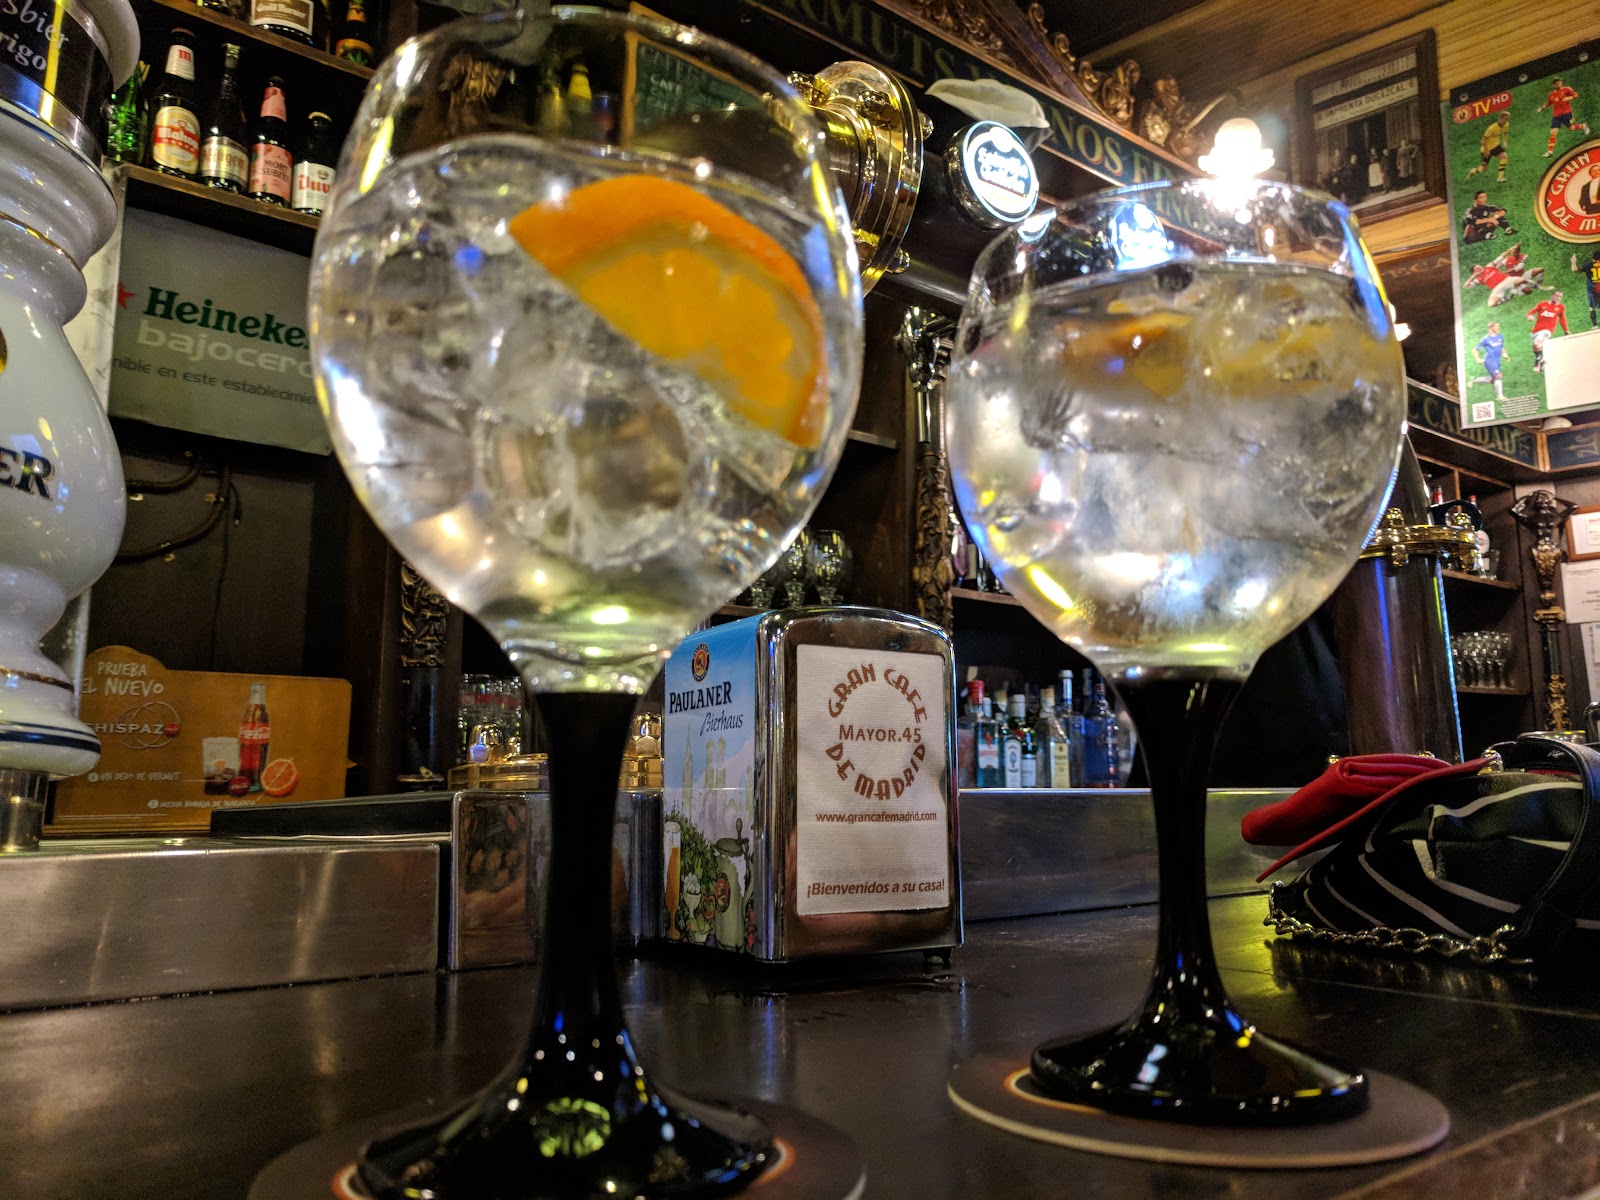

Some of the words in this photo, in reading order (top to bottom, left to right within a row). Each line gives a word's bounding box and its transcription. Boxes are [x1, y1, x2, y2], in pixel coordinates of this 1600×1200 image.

[1473, 98, 1491, 116] TV
[1492, 93, 1509, 106] HD
[1552, 205, 1576, 228] DE
[1579, 217, 1600, 231] M
[143, 286, 310, 350] Heineke
[157, 367, 177, 379] en
[182, 371, 217, 387] este
[97, 661, 148, 677] PRUEBA
[104, 677, 164, 697] NUEVO
[669, 681, 732, 714] PAULANER
[828, 663, 876, 718] GRAN
[700, 709, 744, 737] Bierhaus
[825, 742, 856, 781] DE
[854, 744, 926, 800] MADRID
[815, 811, 937, 824] www.grancafemadrid.com
[807, 881, 889, 898] ¡Bienvenidos
[892, 883, 899, 893] a
[902, 882, 915, 893] su
[918, 879, 945, 892] casa!
